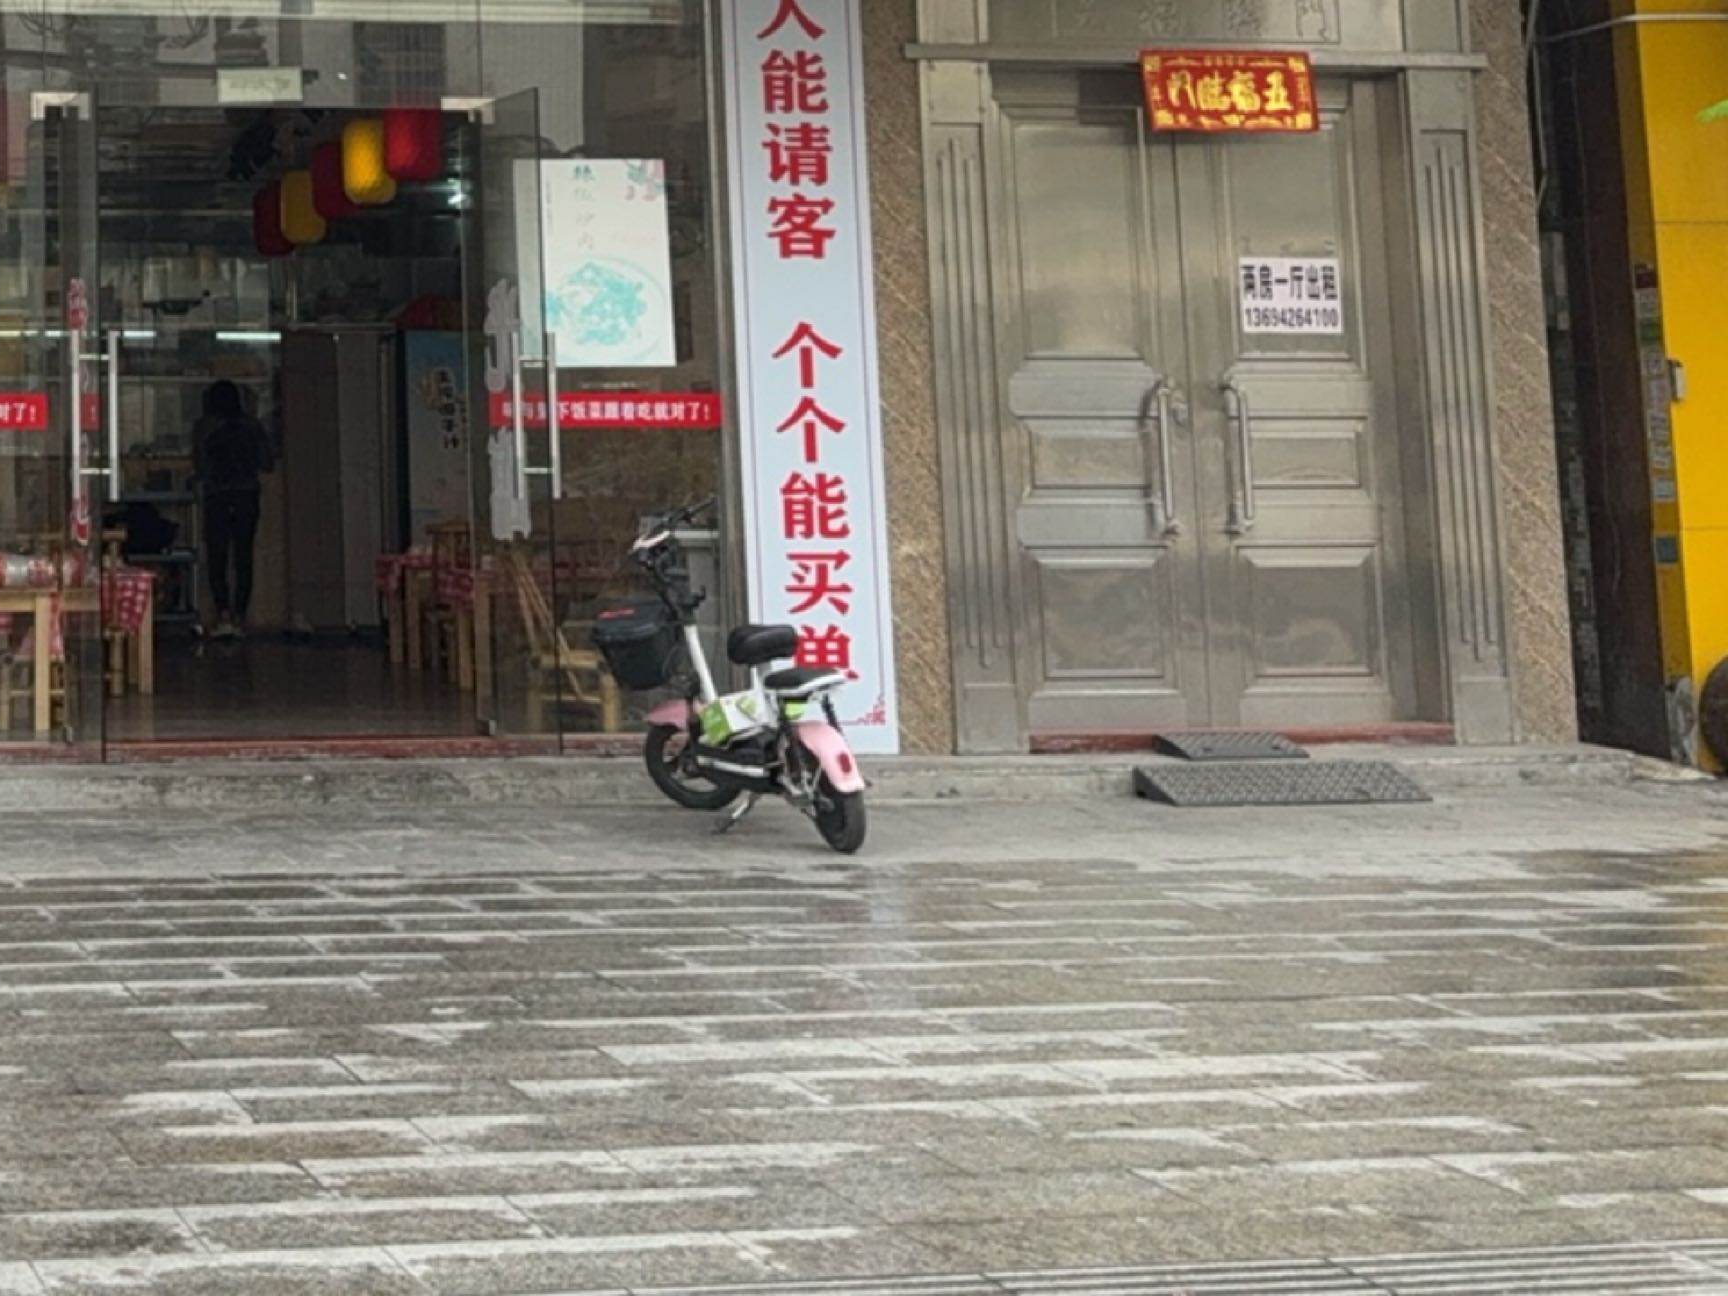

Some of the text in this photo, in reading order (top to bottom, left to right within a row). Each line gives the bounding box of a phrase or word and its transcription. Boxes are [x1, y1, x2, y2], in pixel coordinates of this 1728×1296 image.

[772, 321, 860, 680] 个个能买单
